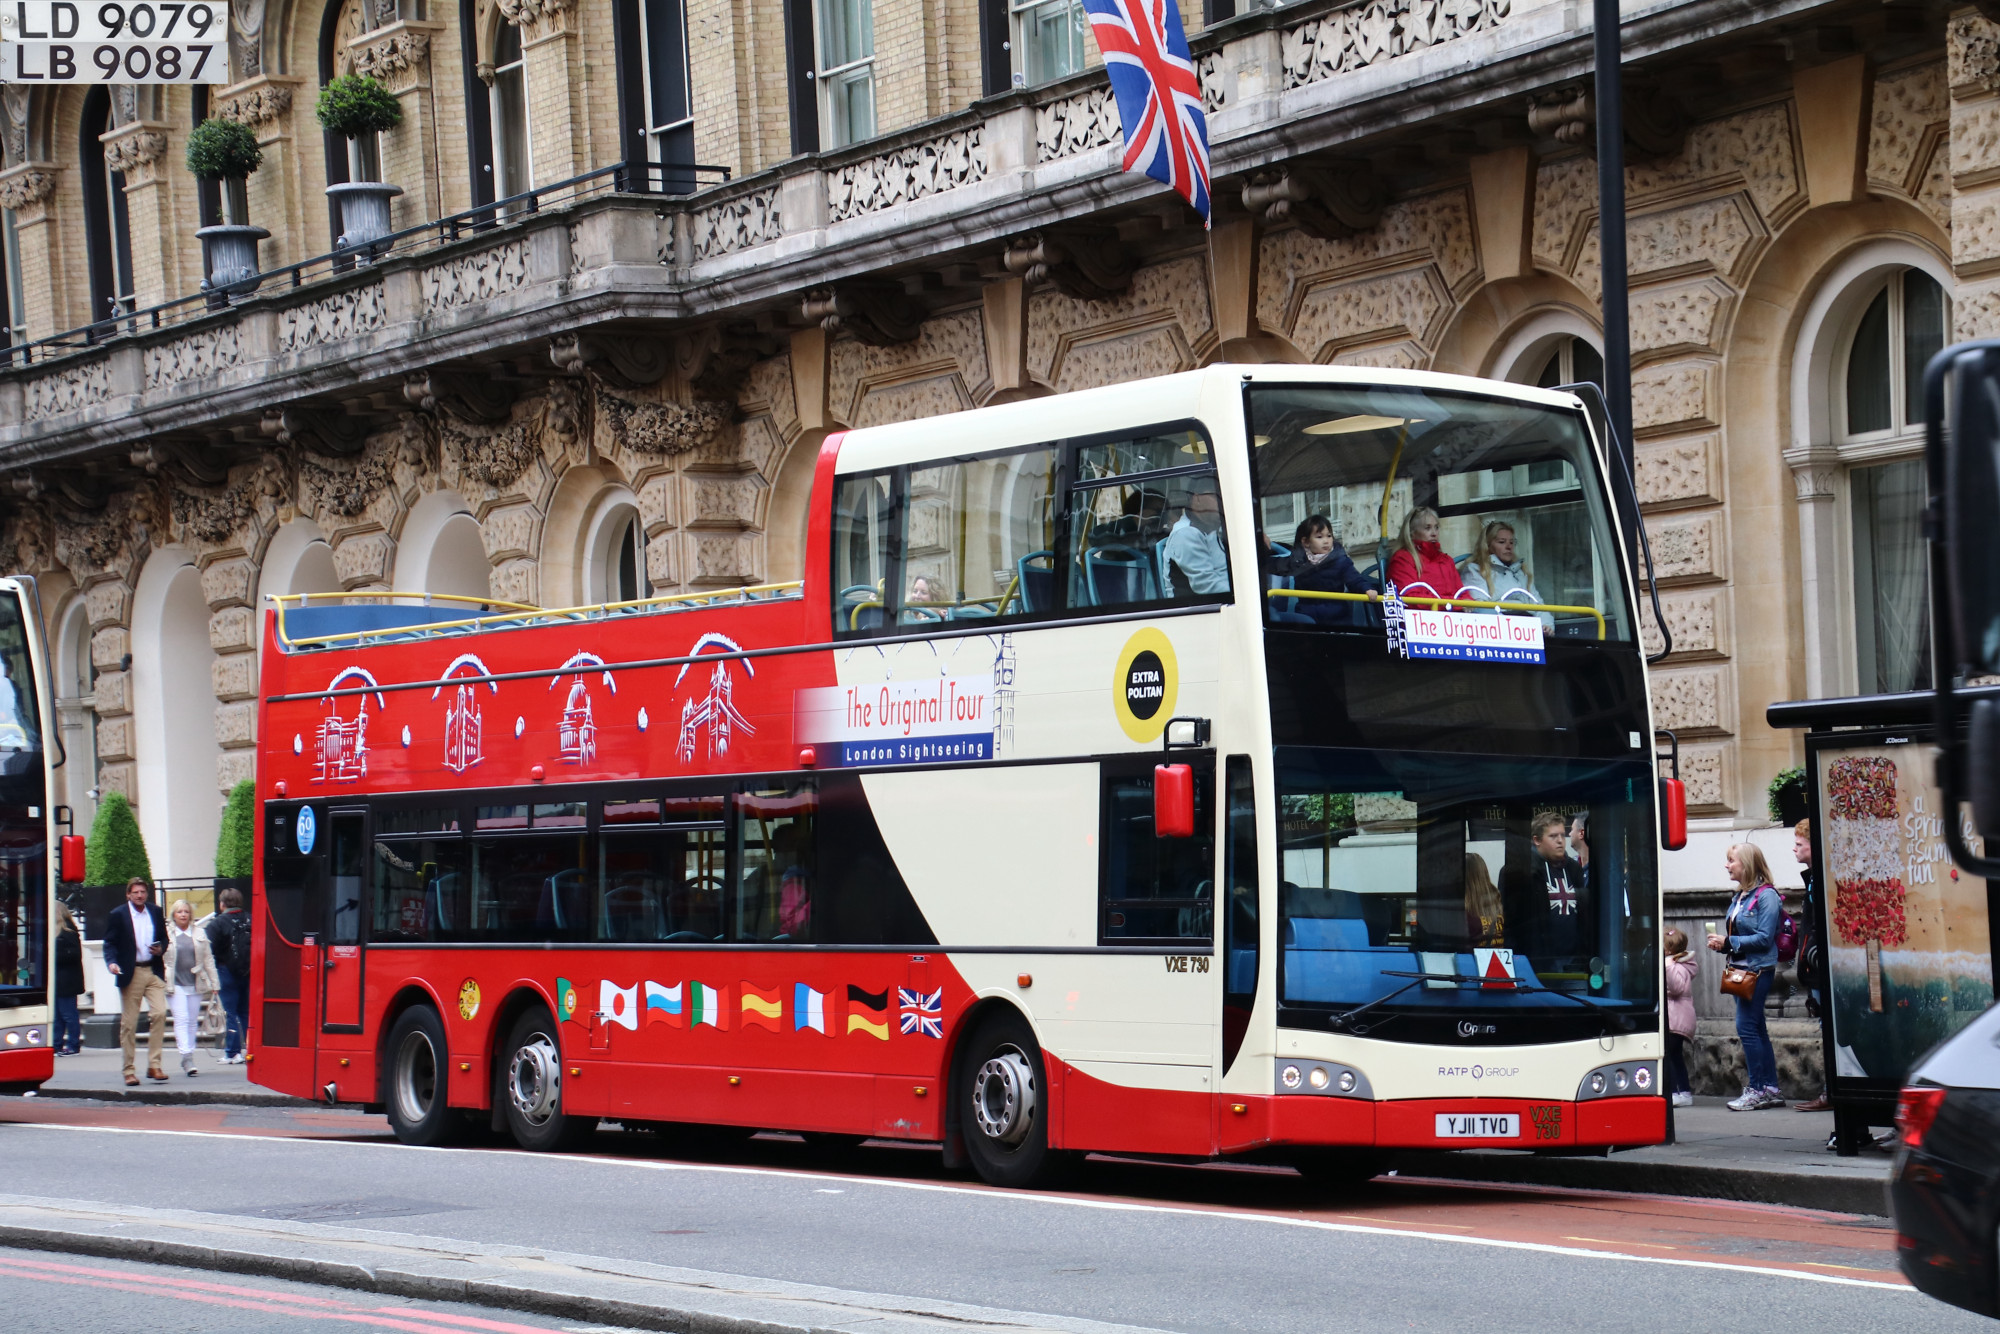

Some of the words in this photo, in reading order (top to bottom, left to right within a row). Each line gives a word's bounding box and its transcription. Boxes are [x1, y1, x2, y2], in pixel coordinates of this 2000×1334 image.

[1412, 613, 1437, 637] The
[1444, 614, 1502, 645] Original
[1506, 618, 1536, 642] Tour
[1414, 645, 1460, 657] London
[1466, 647, 1540, 662] Sightseeing
[1131, 670, 1160, 685] EXTRA
[1127, 685, 1163, 700] POLITAN
[846, 687, 871, 730] The
[878, 679, 943, 736] Original
[949, 681, 985, 722] Tour
[846, 748, 893, 762] London
[899, 741, 984, 759] Sightseeing
[1914, 796, 1925, 814] a
[299, 815, 312, 836] 60
[1283, 819, 1310, 831] HOTEL
[1904, 811, 1975, 841] Sprinle
[1907, 854, 1936, 886] fun
[1165, 956, 1188, 973] VXE
[1190, 956, 1210, 973] 730
[1438, 1066, 1469, 1077] RATP
[1485, 1067, 1520, 1077] GROUP
[1529, 1106, 1562, 1122] VXE
[1535, 1123, 1560, 1139] 730
